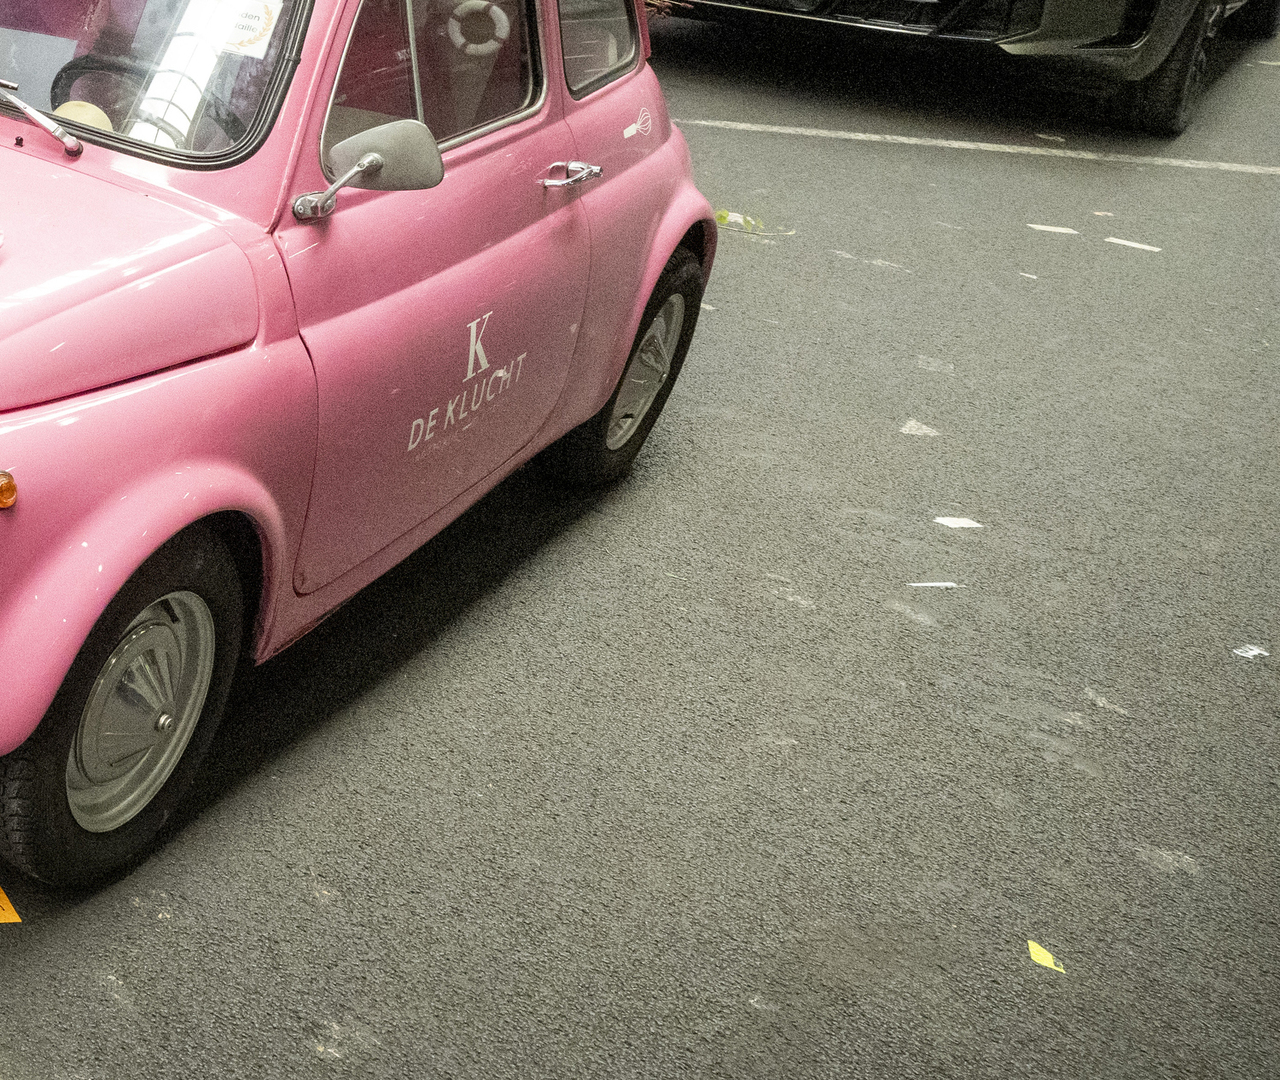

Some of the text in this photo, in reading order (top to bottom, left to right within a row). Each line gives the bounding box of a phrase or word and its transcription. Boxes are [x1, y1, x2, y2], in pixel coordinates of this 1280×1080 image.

[462, 310, 493, 383] K
[407, 351, 528, 452] DE KLUCHT
